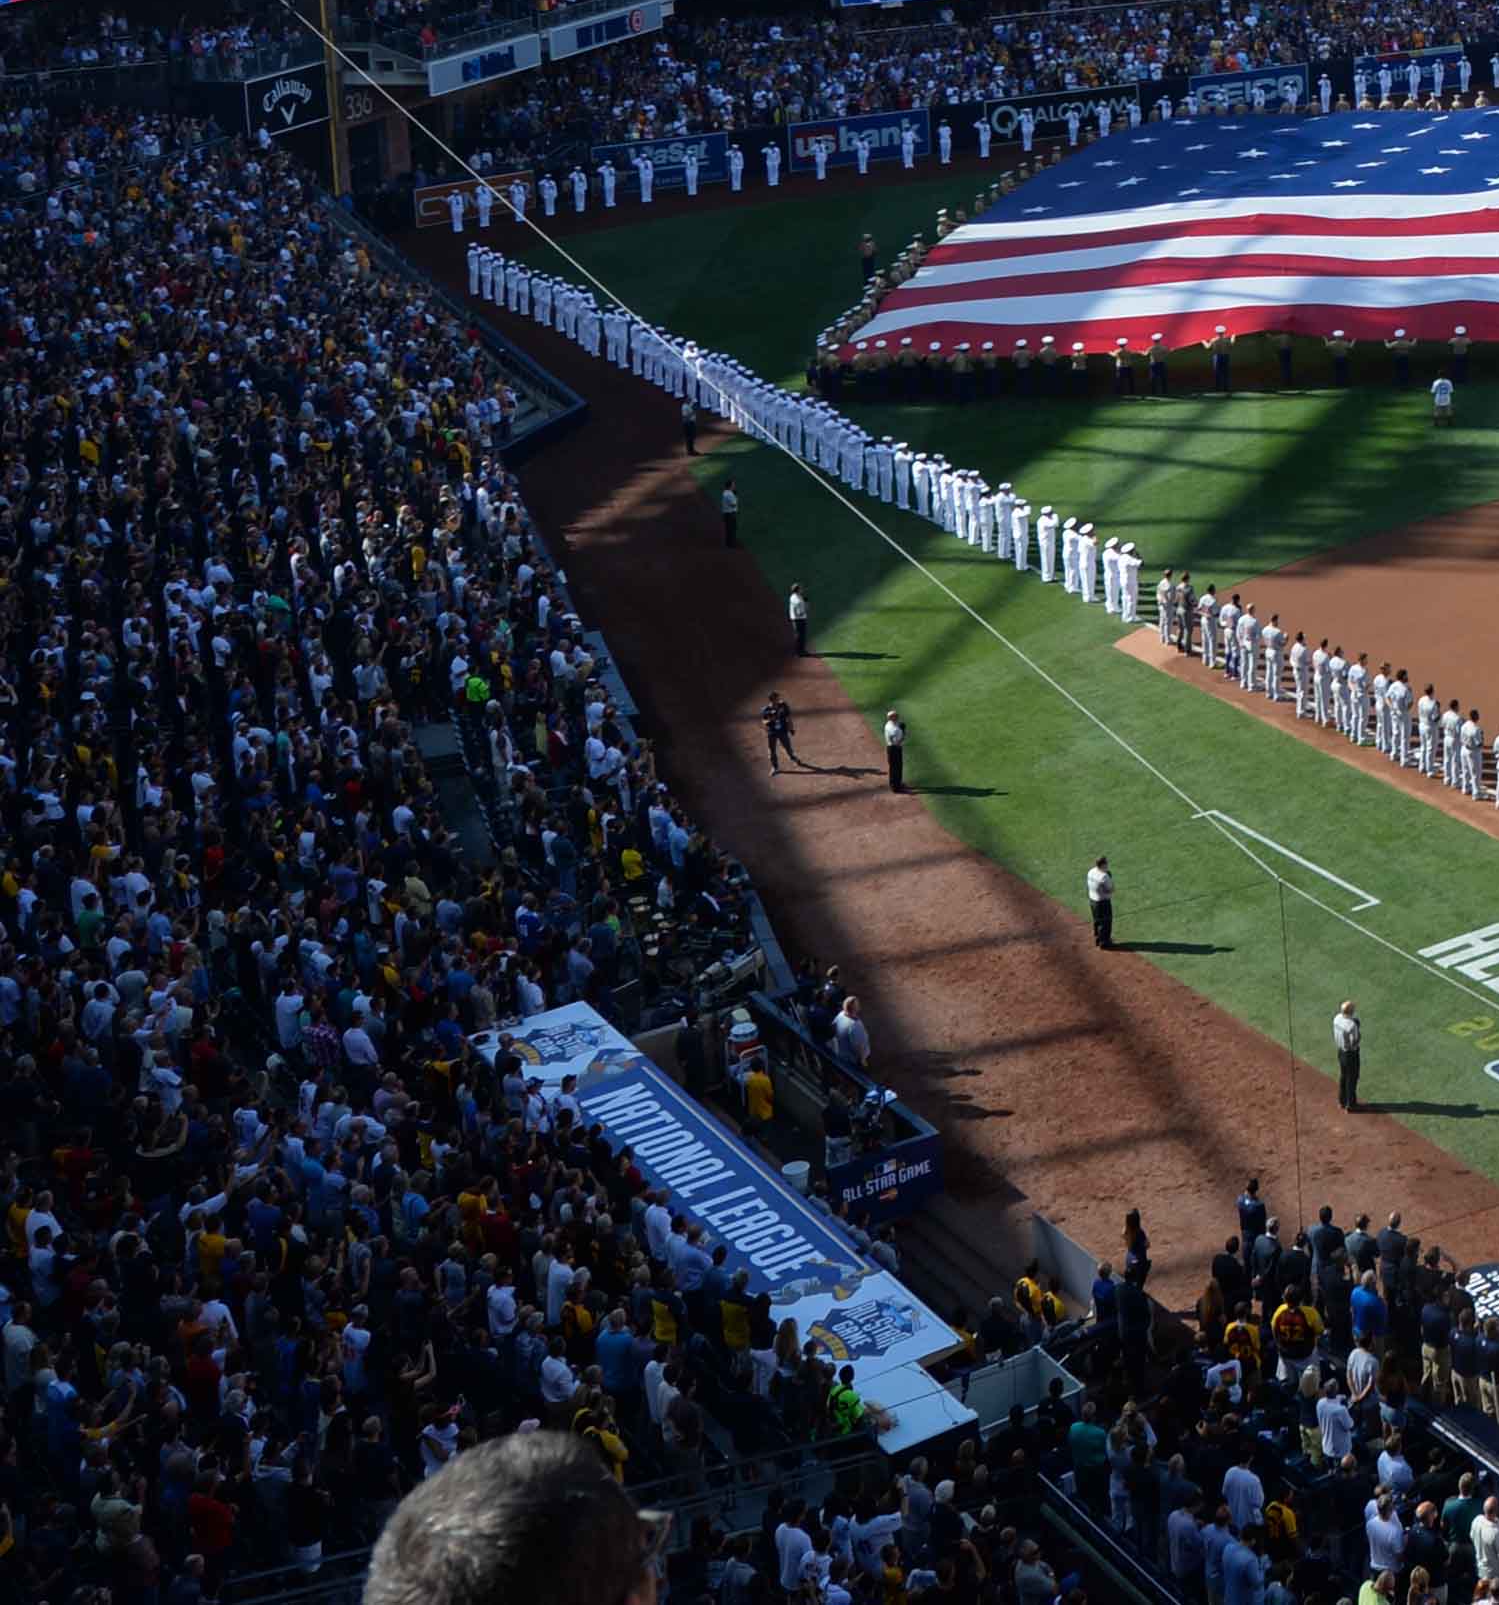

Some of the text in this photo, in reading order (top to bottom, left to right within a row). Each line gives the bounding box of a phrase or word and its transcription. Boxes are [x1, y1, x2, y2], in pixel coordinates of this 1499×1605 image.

[263, 78, 312, 113] Callaway
[344, 92, 373, 120] 336
[580, 1081, 828, 1282] NATIONAL LEAGUE
[843, 1160, 932, 1202] ALL STAR GAME
